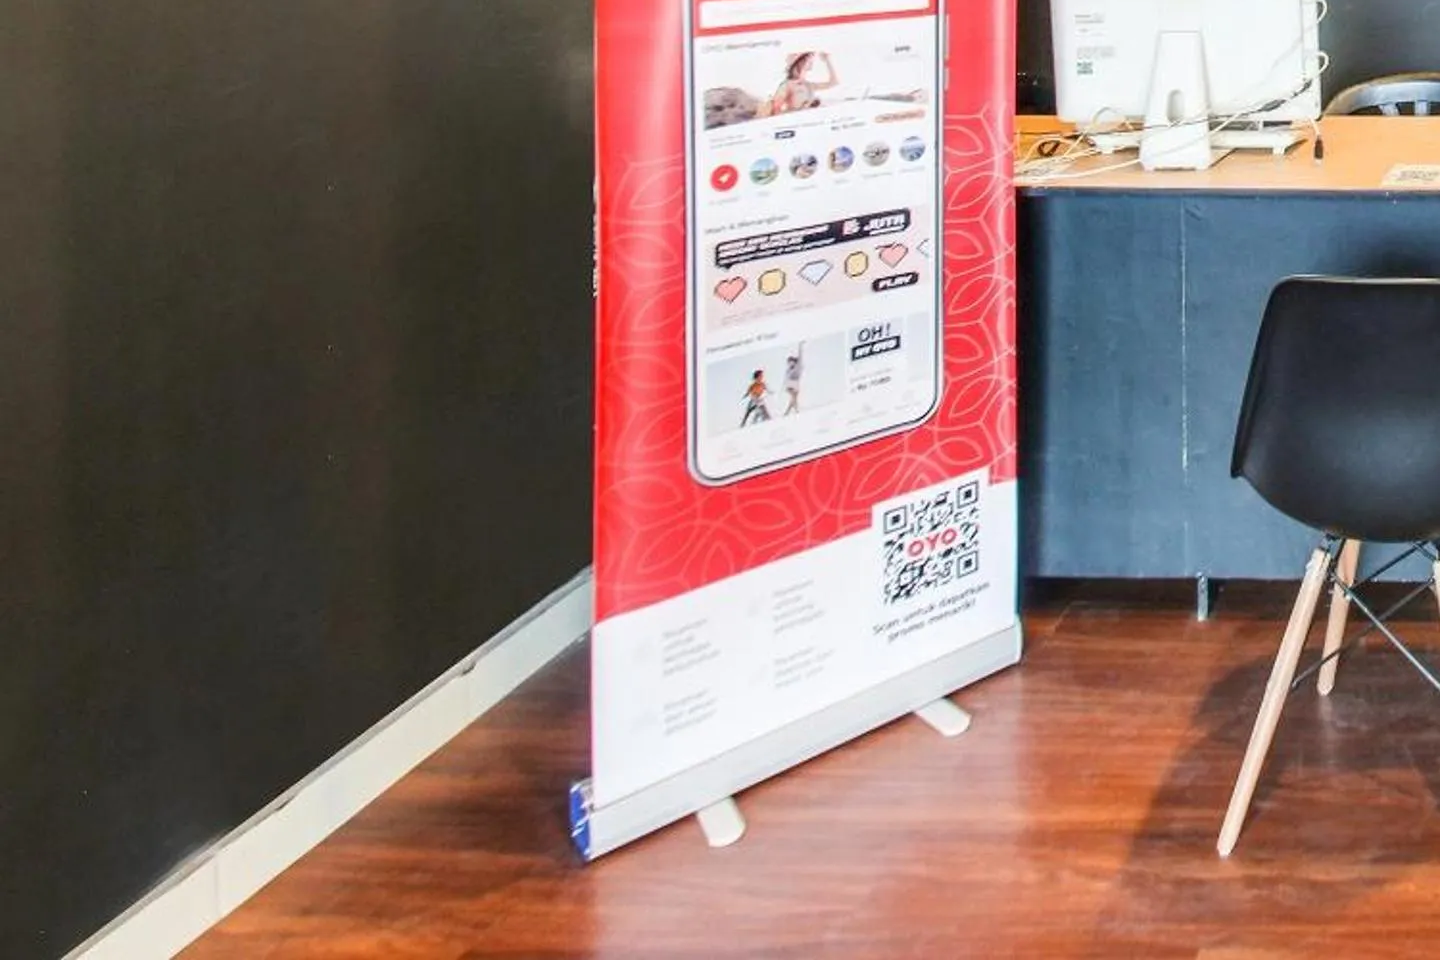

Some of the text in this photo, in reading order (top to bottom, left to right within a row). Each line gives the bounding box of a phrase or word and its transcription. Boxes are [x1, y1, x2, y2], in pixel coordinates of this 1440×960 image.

[907, 527, 958, 557] OYO
[872, 618, 900, 635] Scan
[903, 604, 935, 623] untuk
